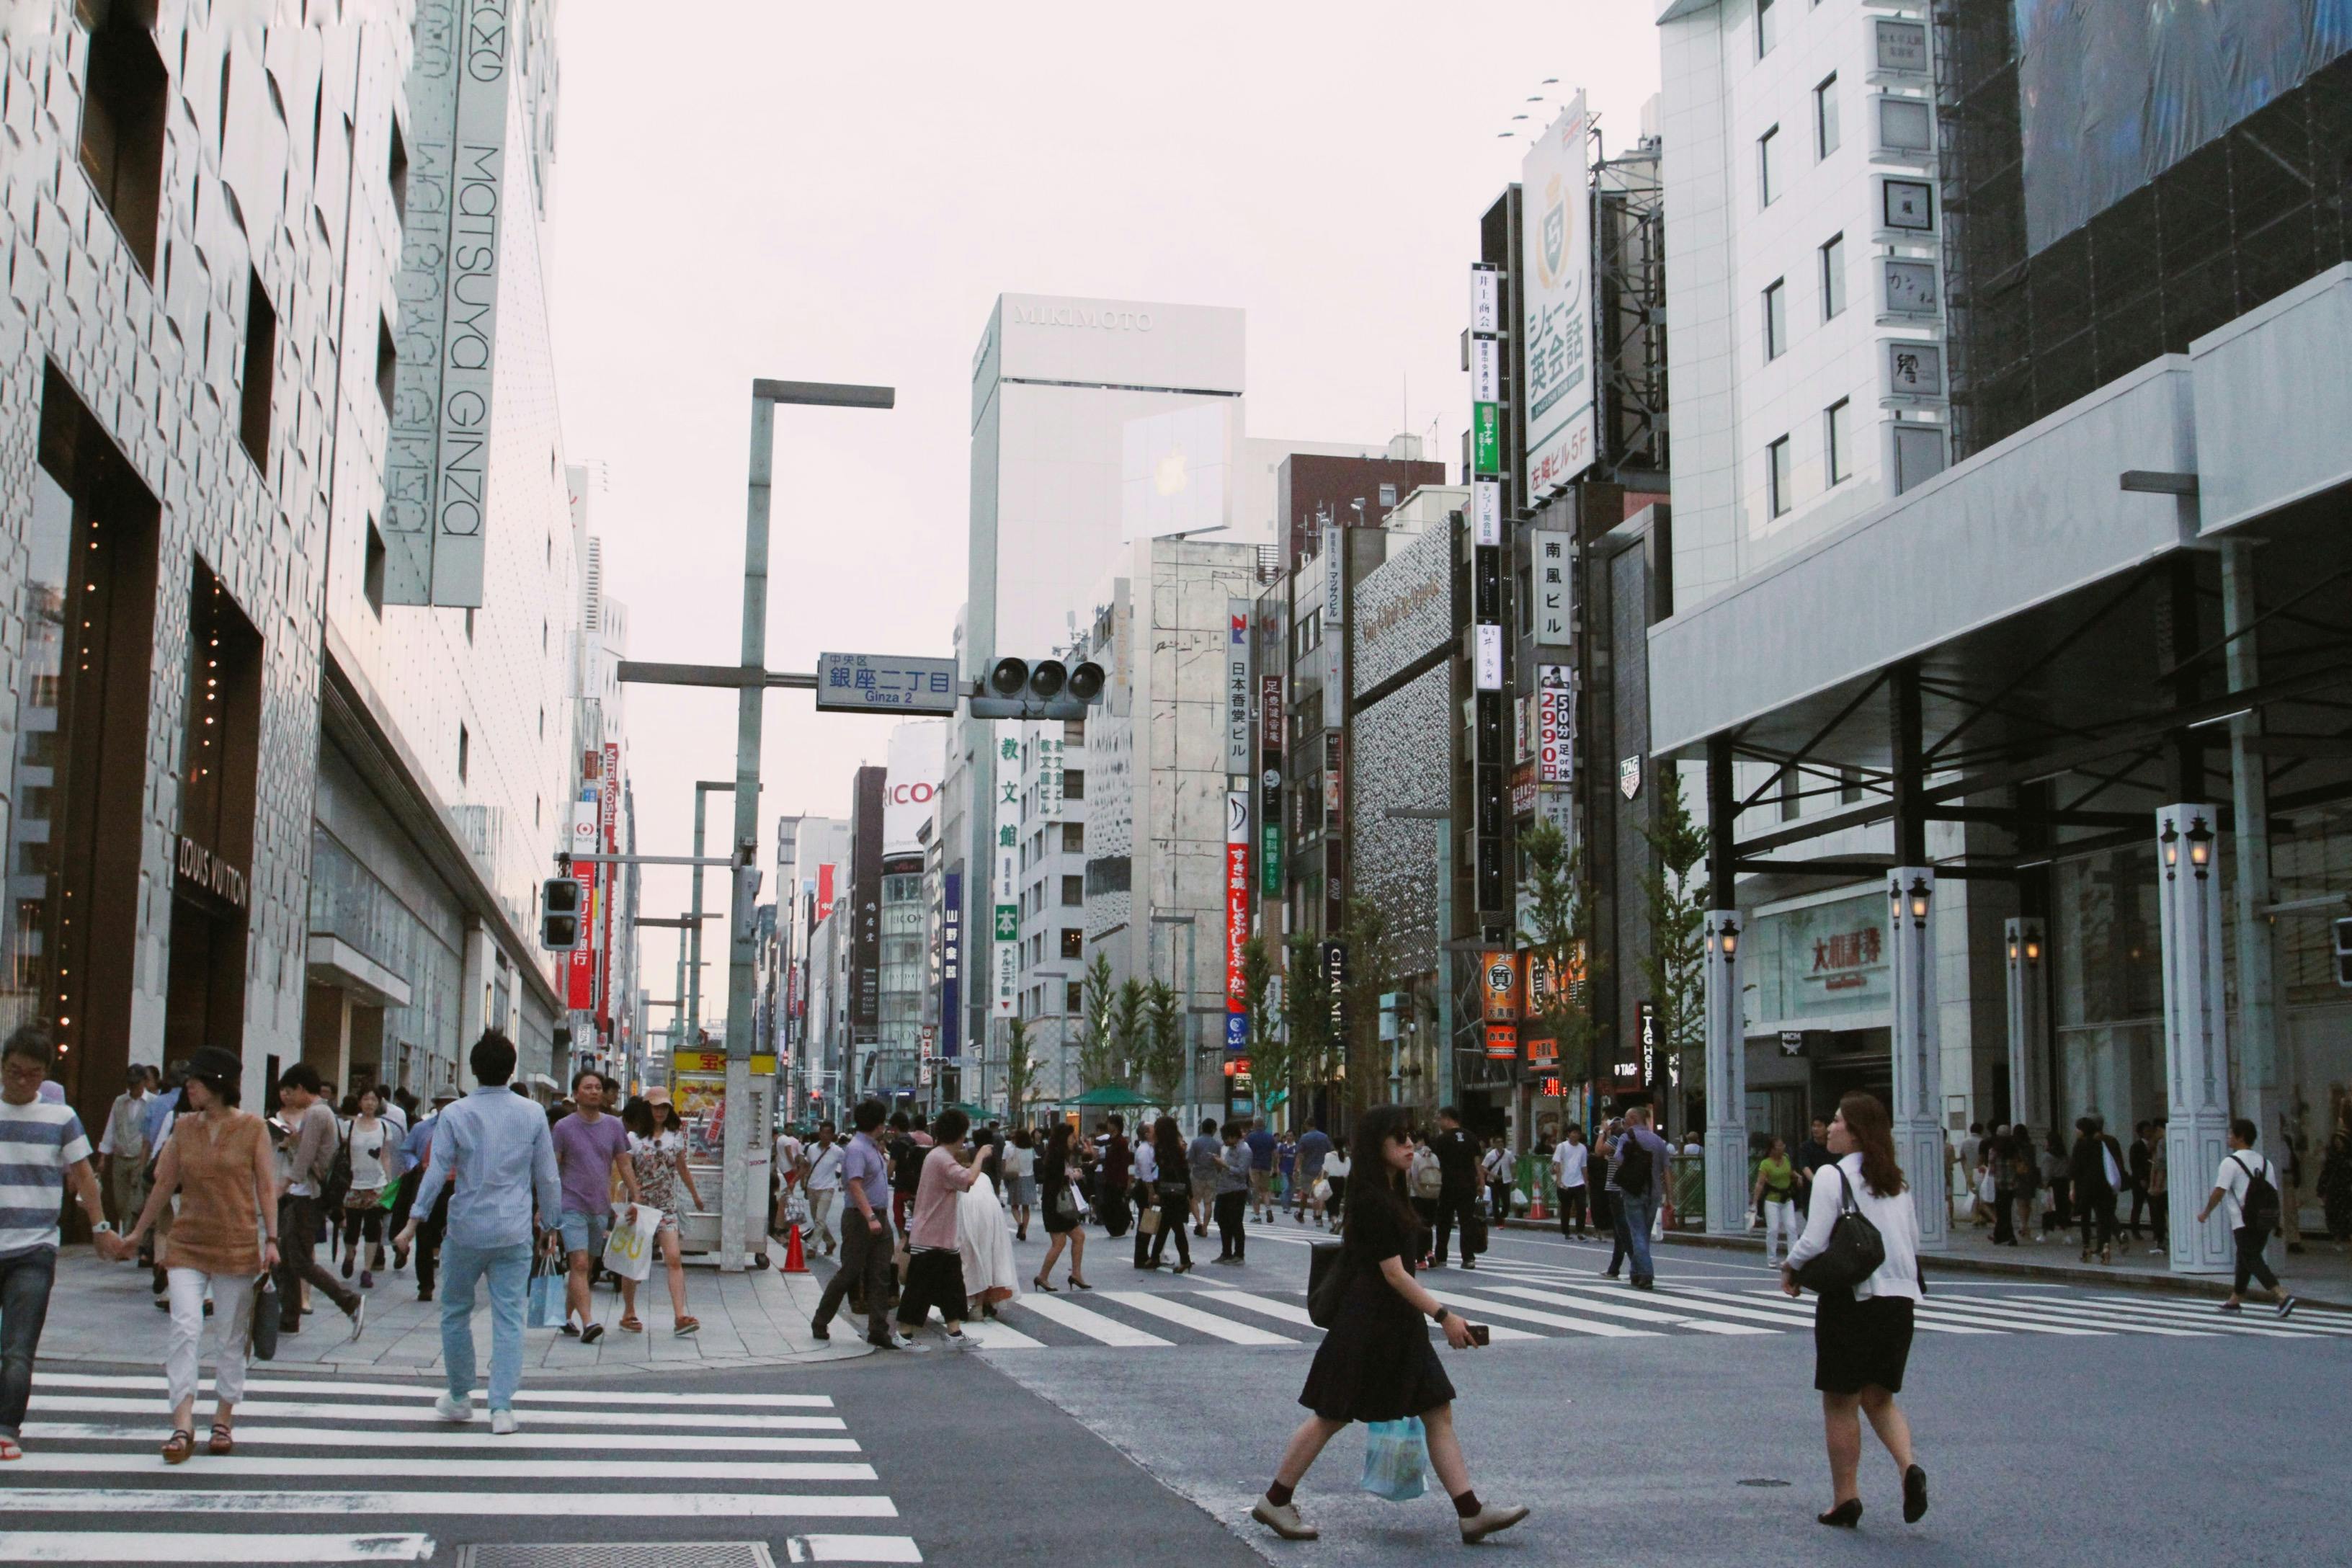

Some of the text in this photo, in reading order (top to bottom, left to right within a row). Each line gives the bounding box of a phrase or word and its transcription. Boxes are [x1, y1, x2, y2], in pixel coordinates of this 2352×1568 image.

[1015, 306, 1154, 332] MIKIMOTO
[1530, 268, 1582, 352] シェーン
[1531, 311, 1584, 400] 英会話
[1545, 542, 1562, 633] 南風ビル
[829, 654, 868, 667] 中央区
[829, 667, 950, 693] 銀座二丁目
[865, 690, 912, 703] Ginza 2
[1231, 662, 1246, 757] 日本香堂ビル
[1558, 695, 1570, 738] 50分
[1541, 692, 1557, 780] 2990円
[1623, 760, 1639, 775] TAG
[605, 747, 617, 825] MITSUKOSHI
[999, 736, 1019, 847] 教文館
[1549, 794, 1562, 803] 3F
[179, 837, 249, 909] LOUIS VUITTON
[998, 909, 1015, 935] 本
[945, 909, 958, 979] 山野楽器
[1497, 953, 1514, 962] 2F
[1492, 968, 1510, 989] 質
[1643, 1015, 1652, 1044] TAG
